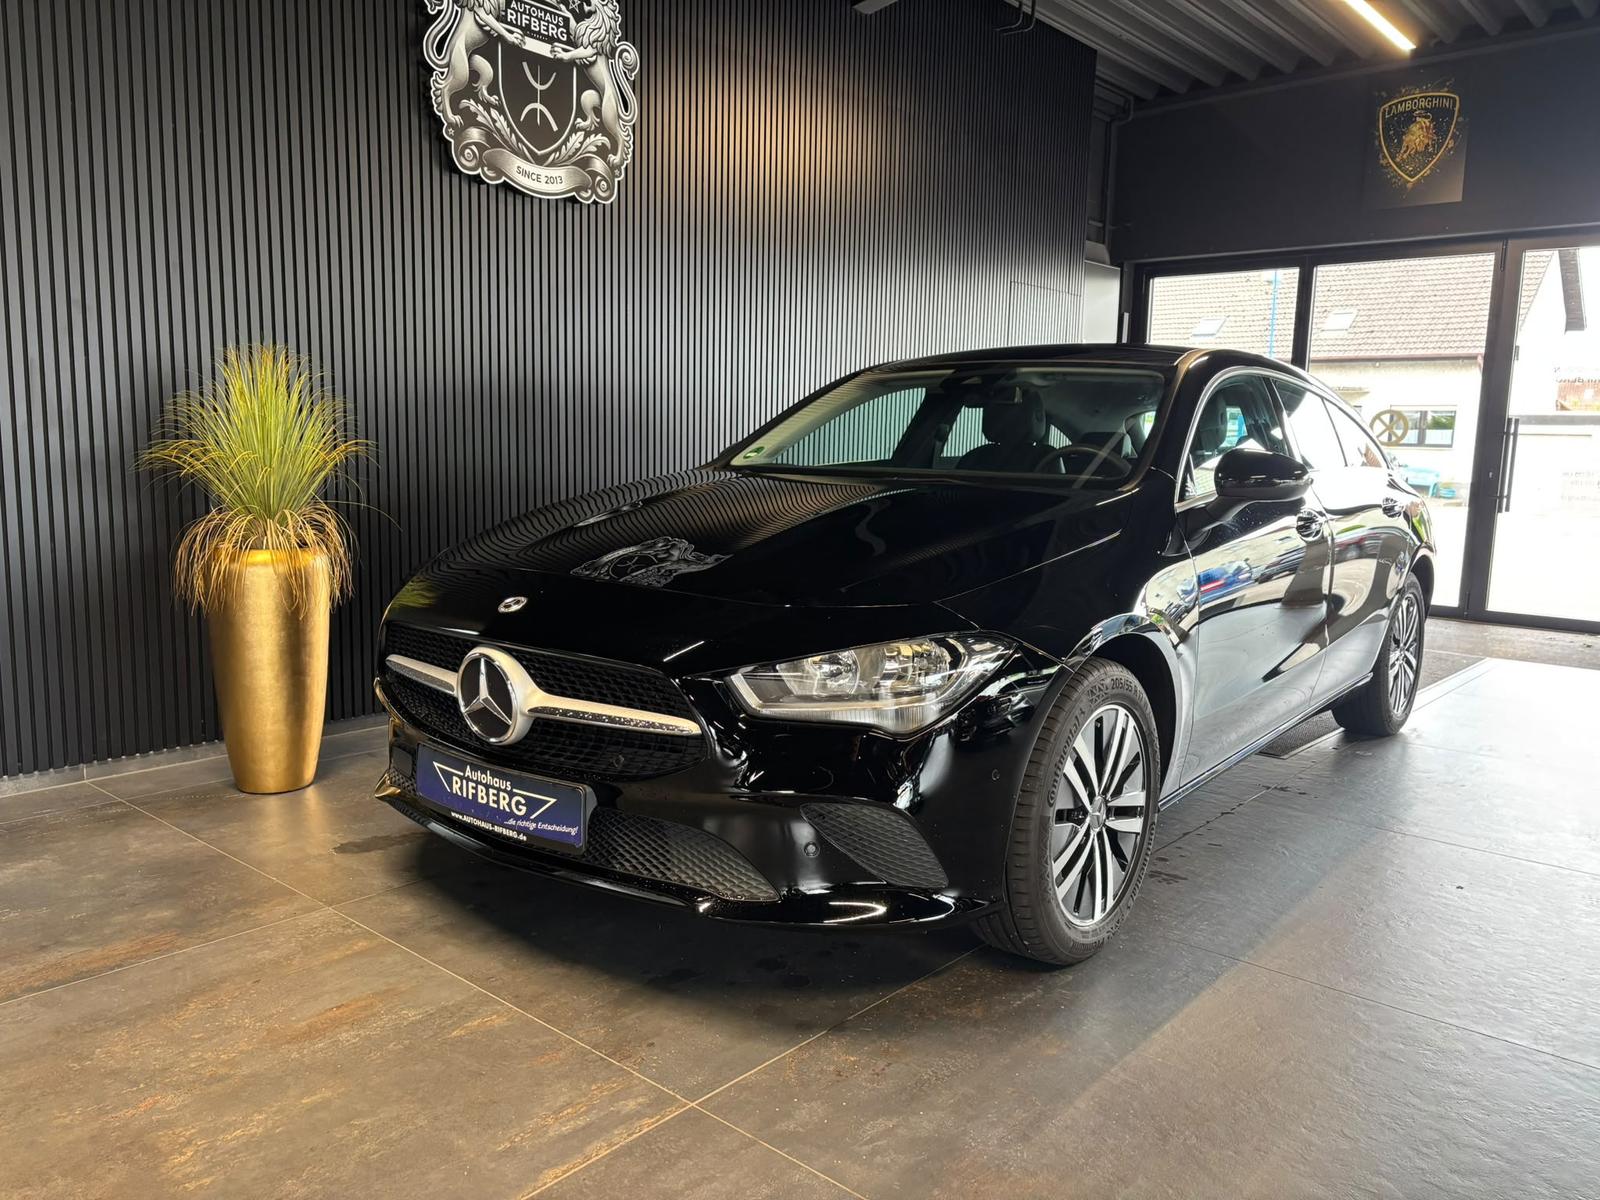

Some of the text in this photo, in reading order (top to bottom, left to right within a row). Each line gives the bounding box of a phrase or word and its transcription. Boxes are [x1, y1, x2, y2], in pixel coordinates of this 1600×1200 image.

[507, 8, 567, 41] RIFBERG
[510, 0, 564, 26] AUTOHAUS
[1385, 96, 1454, 118] LAMBORGHINI
[516, 165, 563, 185] SINCE 2013
[464, 765, 512, 791] Autohaus
[452, 775, 527, 816] RIFBERG
[451, 811, 527, 841] www.AUTOHAUS-RIFBERG.de
[516, 820, 537, 831] richtige
[537, 822, 579, 835] Entscheidung!
